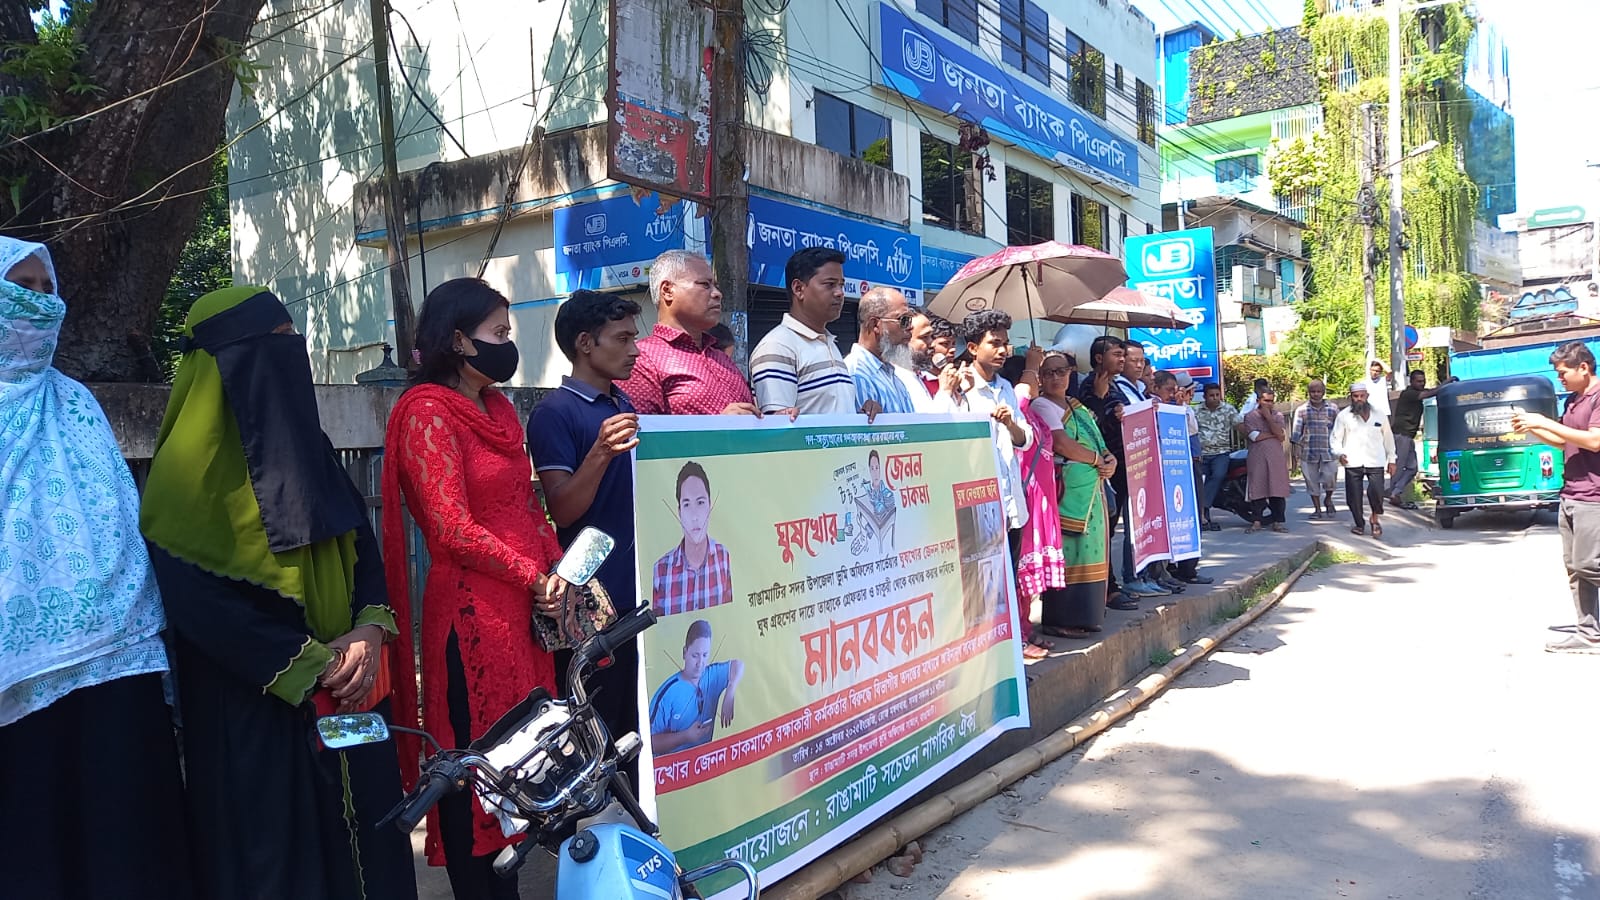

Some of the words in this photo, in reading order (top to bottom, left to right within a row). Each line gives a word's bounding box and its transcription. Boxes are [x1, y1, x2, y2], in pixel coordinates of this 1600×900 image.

[939, 55, 1007, 116] জনতা
[1012, 94, 1065, 141] ব্যাংক
[1069, 118, 1131, 176] পিএলসি.
[562, 243, 581, 257] জনতা
[582, 240, 601, 253] ব্যাংক
[603, 232, 630, 249] পিএলসি.
[645, 221, 671, 236] ATM
[757, 222, 797, 250] জনতা
[837, 233, 883, 267] পিএলসি.
[886, 255, 908, 275] ATM
[885, 453, 923, 491] জেনন
[899, 483, 930, 509] চাকমা
[774, 512, 838, 564] ঘুষখোর
[748, 581, 787, 608] রাঙামাটির
[789, 579, 805, 596] সদর
[806, 572, 835, 591] উপজেলা
[849, 561, 874, 579] অফিসের
[899, 546, 922, 569] ঘুষখোর
[923, 543, 939, 560] জেনন
[940, 540, 956, 556] চাকমা
[757, 617, 769, 636] ঘুষ
[770, 609, 797, 632] গ্রহণের
[799, 604, 815, 621] দায়ে
[817, 595, 841, 614] তাহাকে
[869, 587, 875, 598] ও
[893, 577, 907, 592] থেকে
[800, 593, 934, 690] মানববন্ধন
[694, 747, 727, 775] জেনন
[730, 729, 773, 761] চাকমাকে
[776, 710, 812, 743] রক্ষাকারী
[815, 694, 847, 724] কর্মকর্তার
[849, 688, 872, 710] বিরুদ্ধে
[874, 672, 899, 700] বিভাগীয়
[792, 746, 810, 763] তারিখ
[724, 808, 811, 864] আয়োজনে
[814, 811, 821, 826] :
[826, 764, 878, 819] রাঙামাটি
[880, 747, 920, 787] সচেতন
[921, 722, 956, 760] নাগরিক
[958, 710, 977, 738] ঐক্য
[637, 854, 662, 879] TVS
